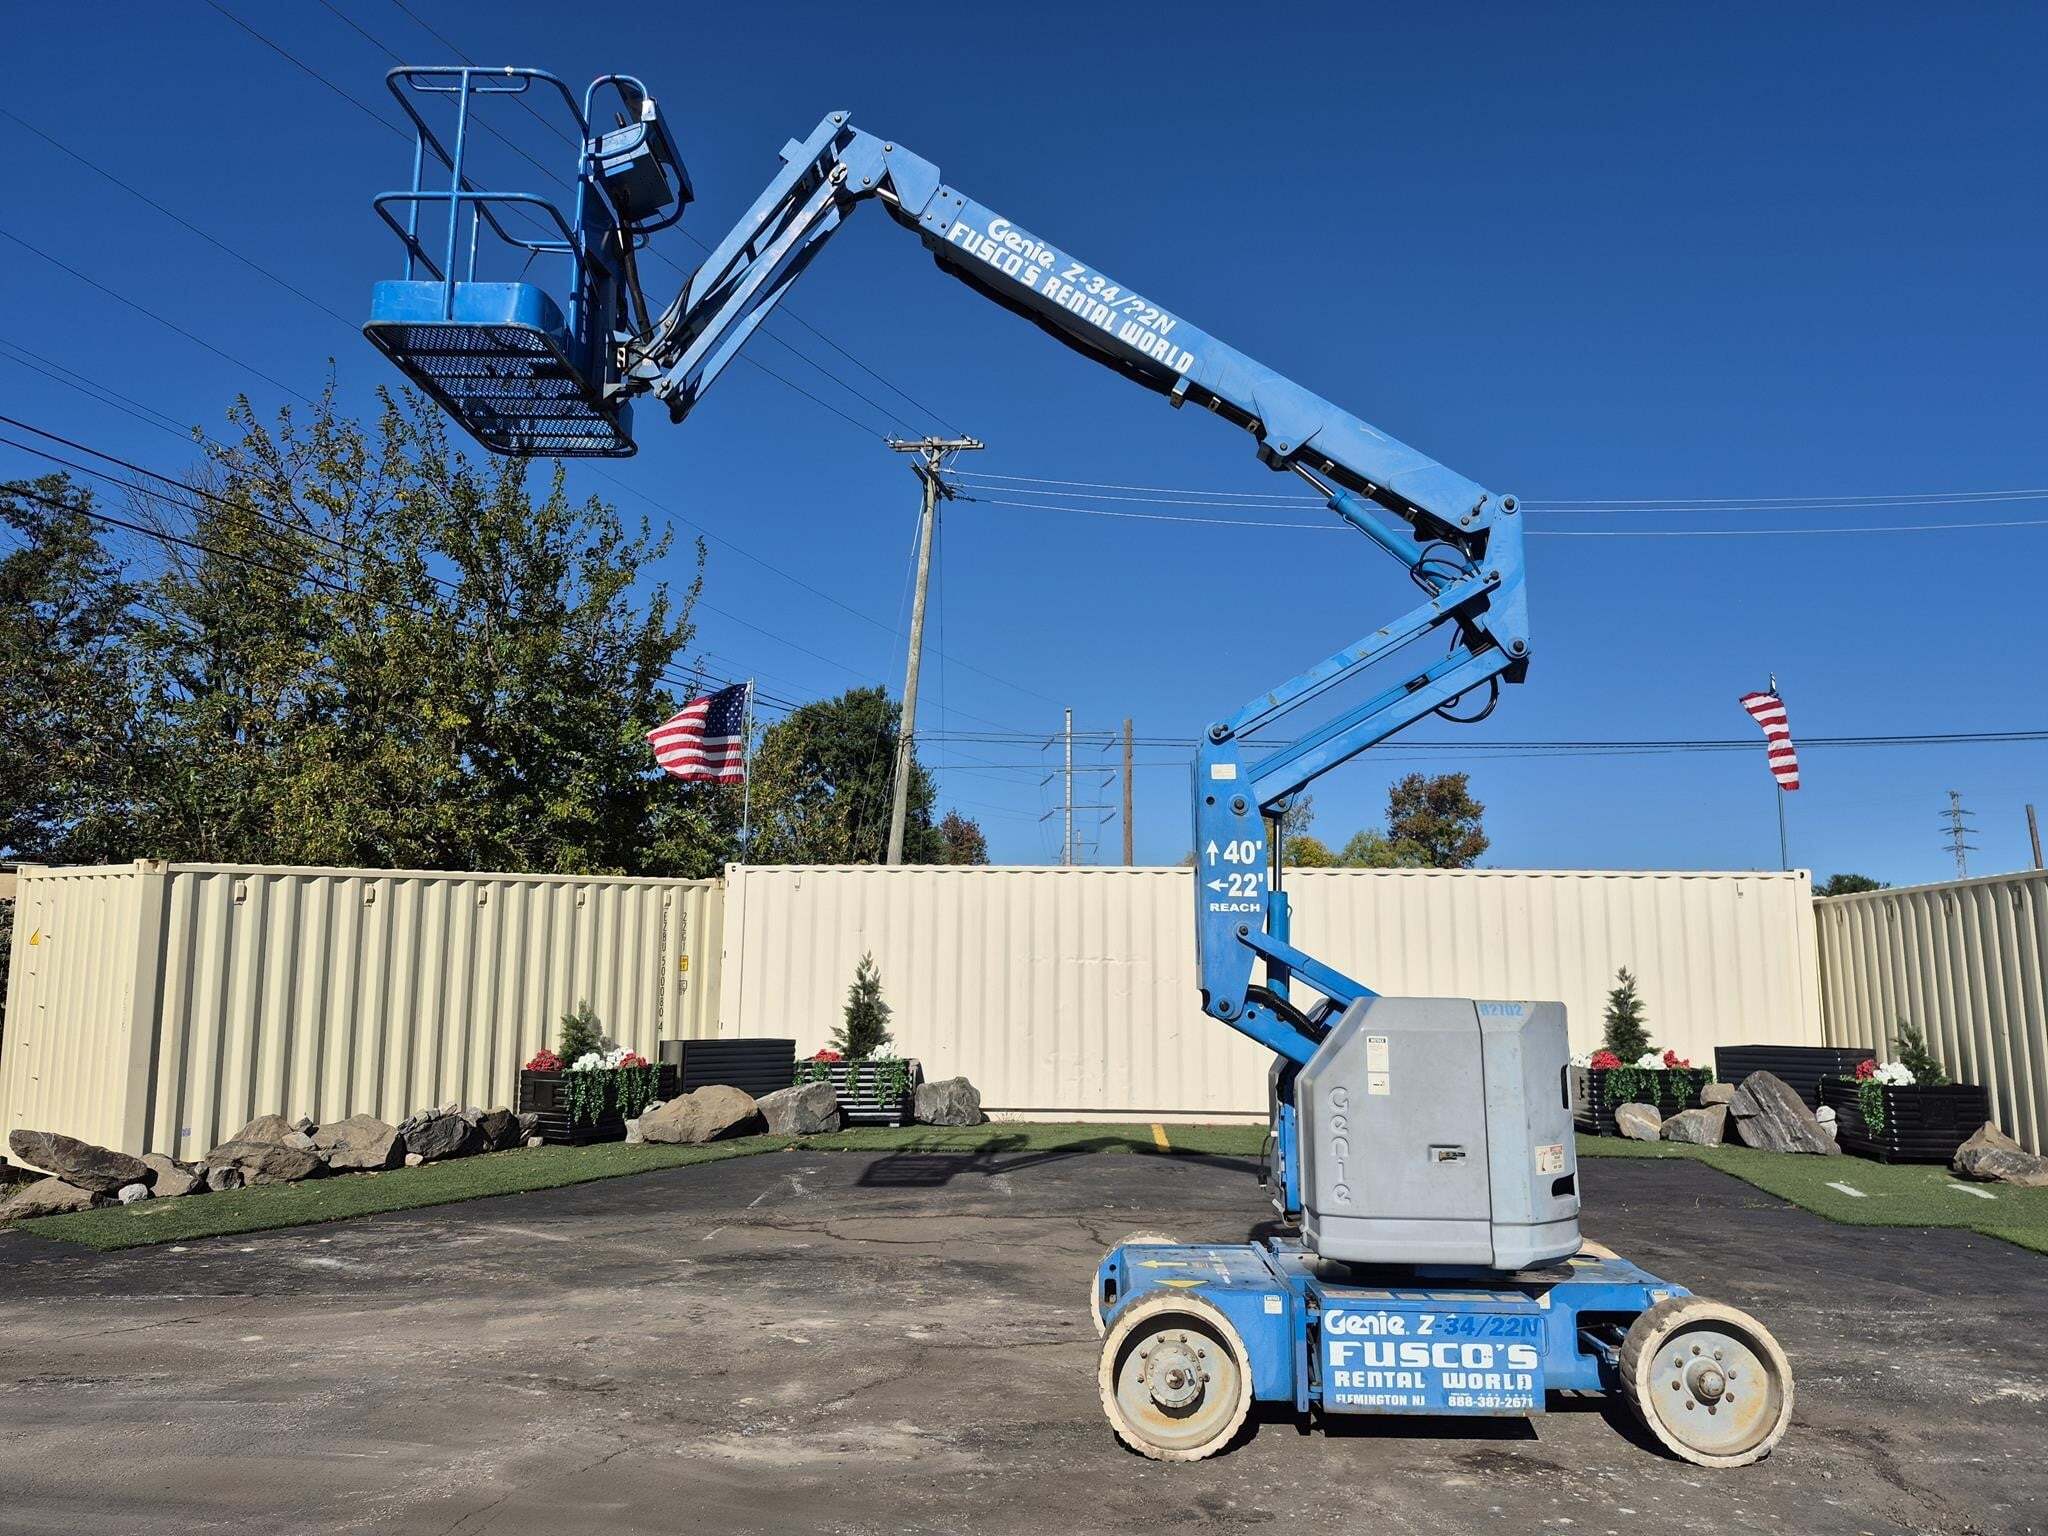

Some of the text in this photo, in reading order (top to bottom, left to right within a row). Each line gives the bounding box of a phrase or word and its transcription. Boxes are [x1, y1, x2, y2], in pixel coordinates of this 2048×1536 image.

[987, 218, 1056, 269] Genie
[947, 221, 1195, 375] FUSCO'S RENTAL WORLD
[1223, 840, 1262, 865] 40'
[1228, 872, 1264, 897] 22'
[1209, 903, 1261, 912] REACH
[1327, 1086, 1352, 1204] Genie
[1324, 1309, 1539, 1337] Genie Z-34/22N
[1328, 1341, 1538, 1370] FUSCO'S
[1334, 1370, 1533, 1391] RENTAL WORLD
